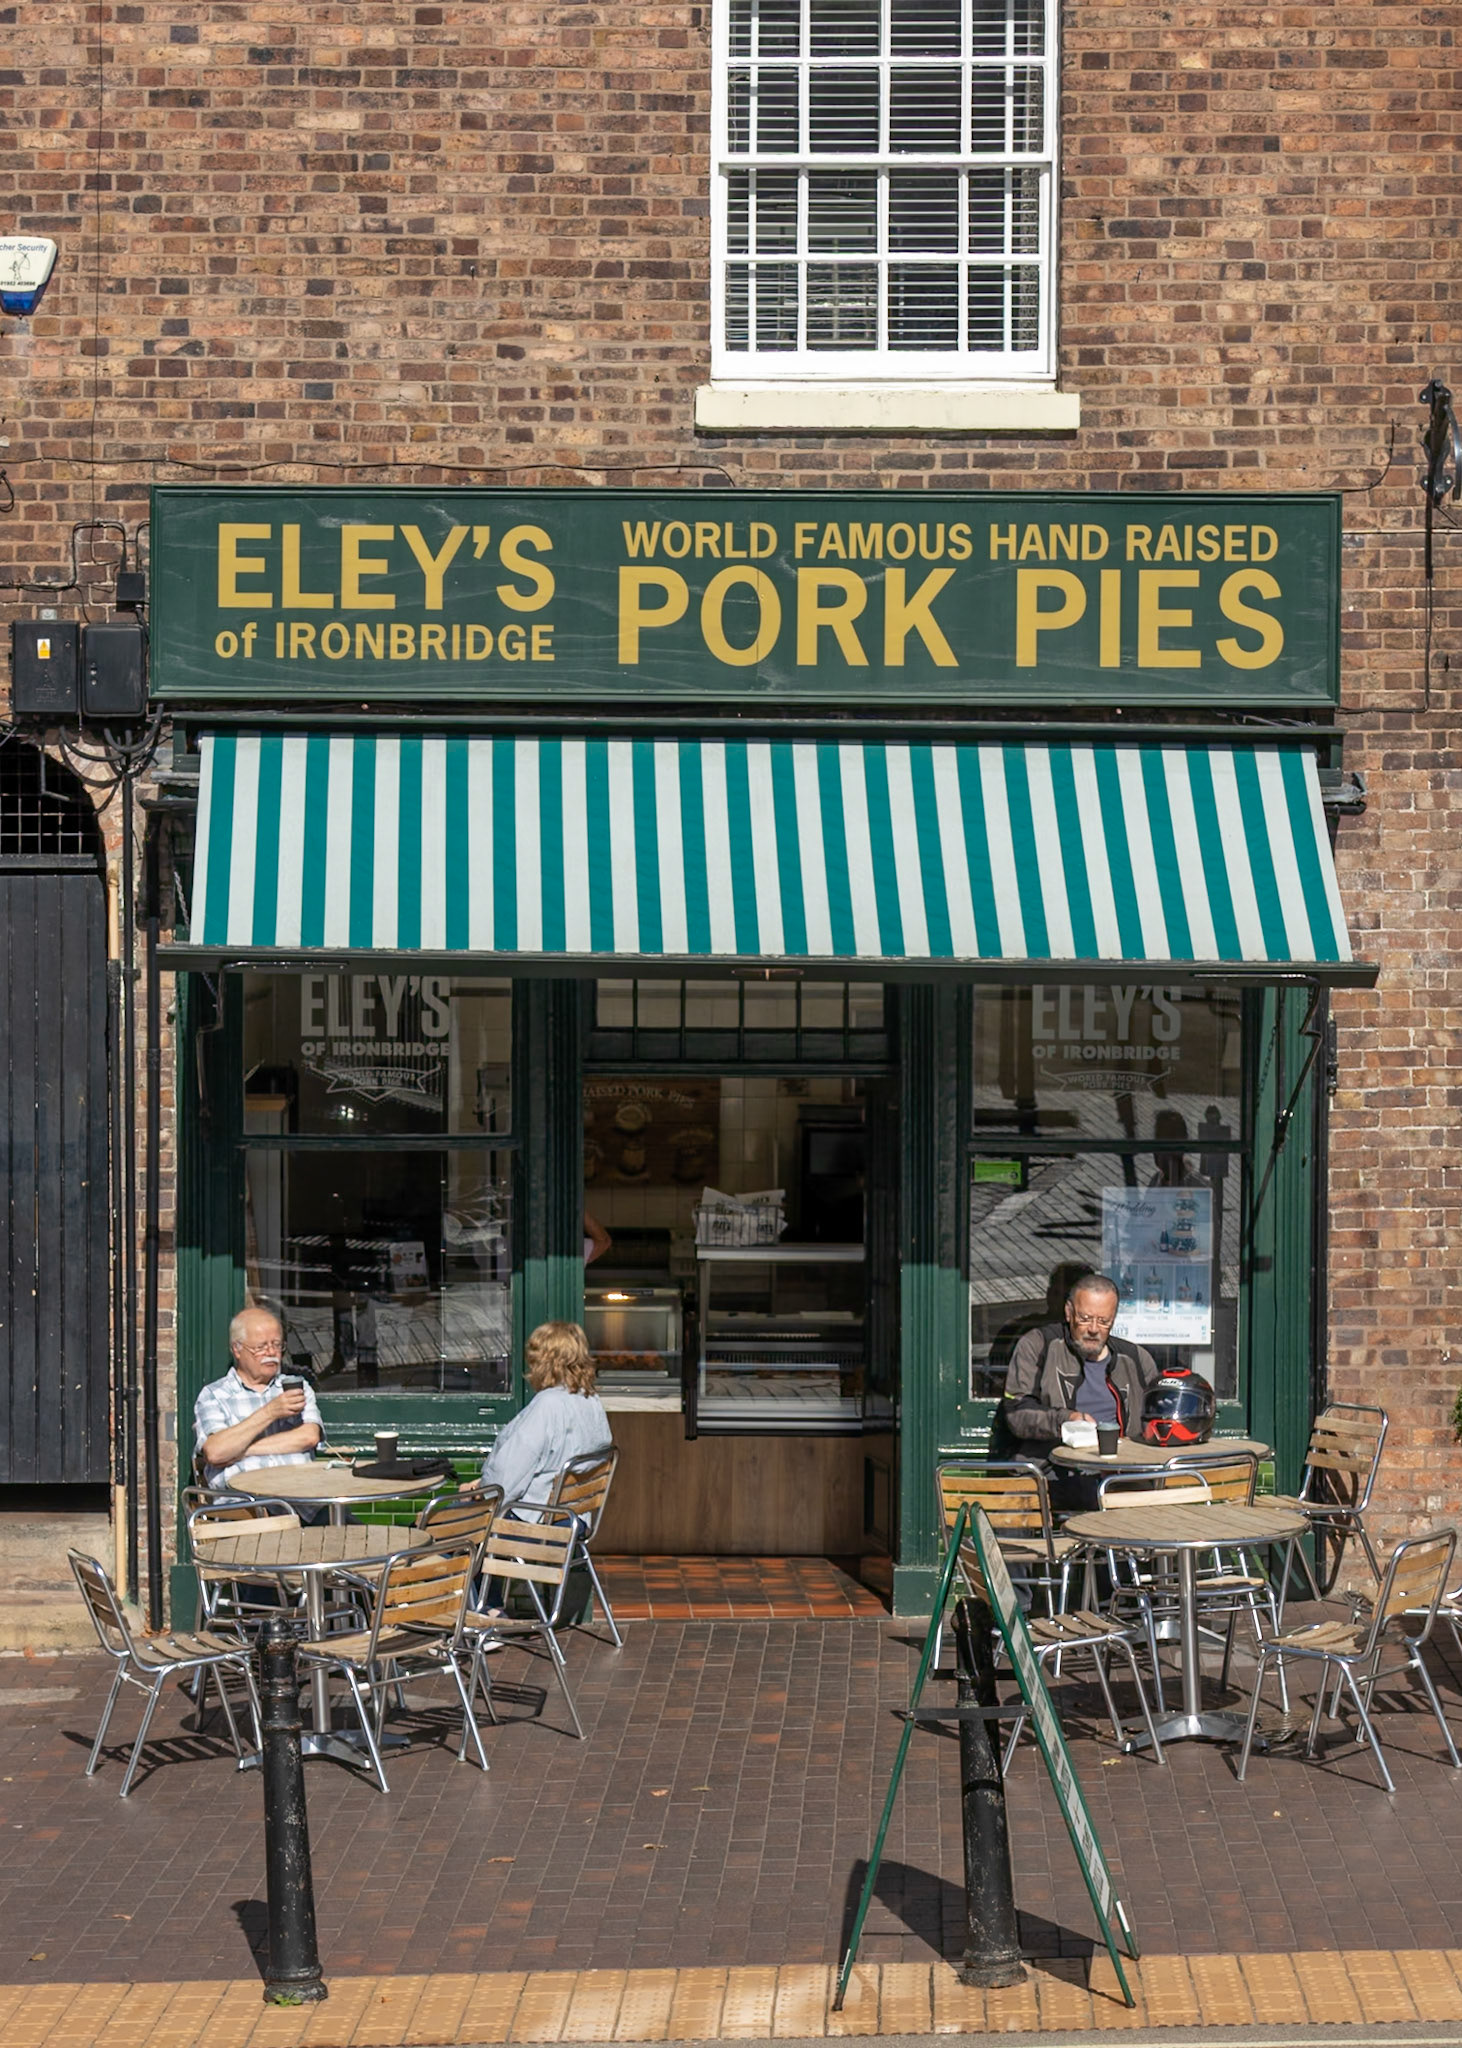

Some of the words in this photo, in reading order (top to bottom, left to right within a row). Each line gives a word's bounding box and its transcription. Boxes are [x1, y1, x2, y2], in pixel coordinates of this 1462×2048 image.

[17, 243, 48, 253] Security
[622, 521, 778, 559] WORLD
[794, 521, 973, 561] FAMOUS
[989, 523, 1110, 561] HAND
[1126, 524, 1279, 562] RAISED
[217, 523, 556, 613] ELEY'S
[618, 564, 960, 669] PORK
[1015, 567, 1285, 670] PIES
[214, 622, 258, 660] of
[276, 622, 556, 662] IRONBRIDGE
[301, 974, 450, 1037] ELEY'S
[1032, 985, 1182, 1041] ELEY'S
[301, 1042, 326, 1056] OF
[333, 1042, 450, 1056] IRONBRIDGE
[1032, 1045, 1057, 1060] OF
[1063, 1045, 1181, 1060] IRONBRIDGE
[338, 1071, 374, 1080] WORLD
[1068, 1075, 1103, 1083] WORLD
[1106, 1075, 1146, 1084] FAMOUS
